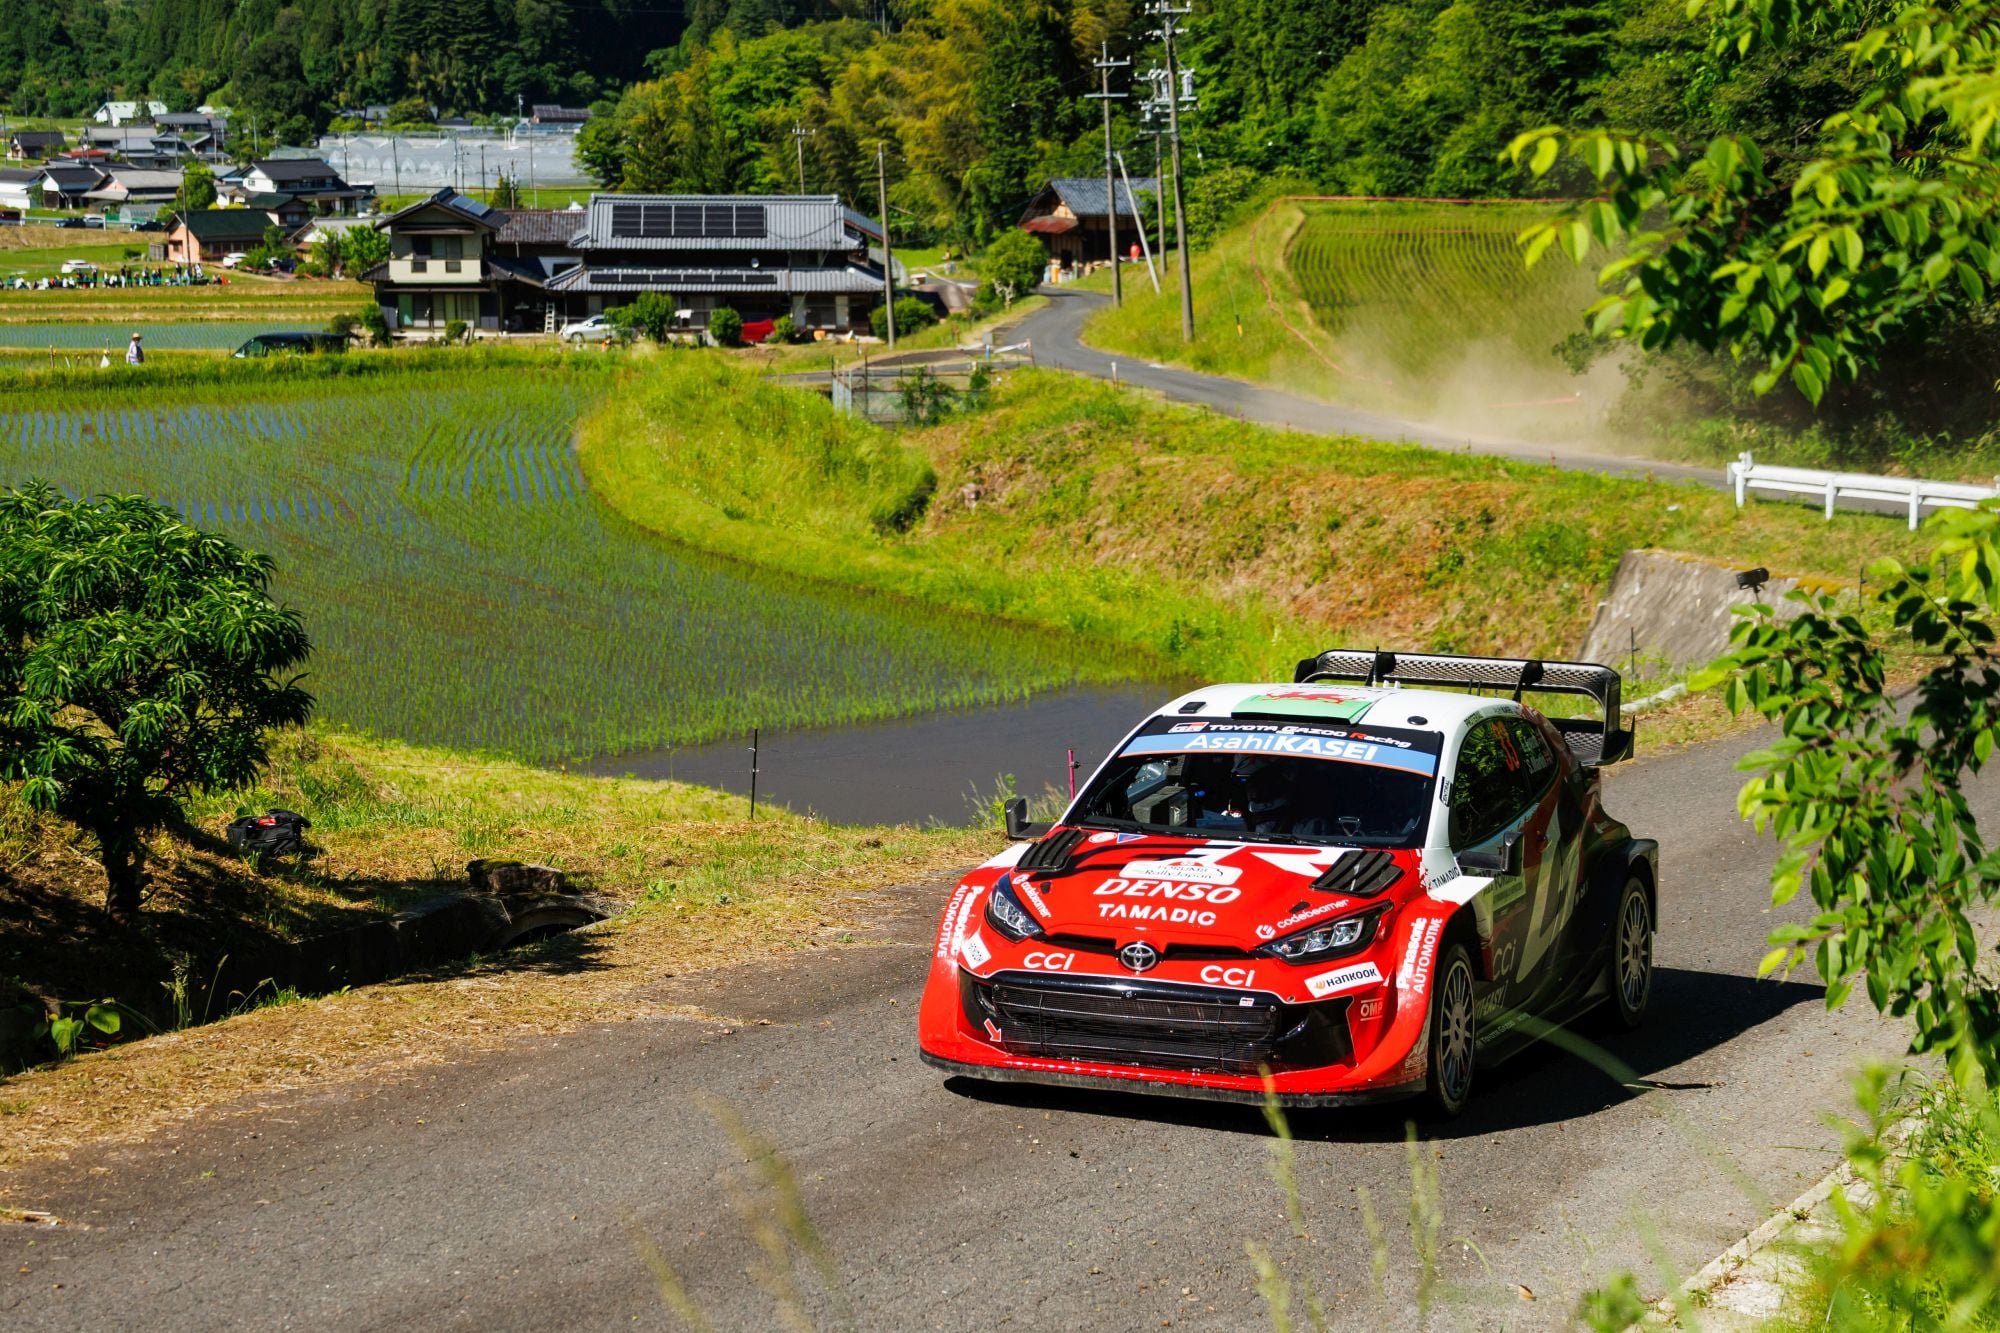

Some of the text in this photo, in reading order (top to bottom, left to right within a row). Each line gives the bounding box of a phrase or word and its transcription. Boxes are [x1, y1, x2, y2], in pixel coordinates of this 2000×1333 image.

[1208, 723, 1278, 734] TOYOTA
[1277, 725, 1348, 738] GAZOO
[1349, 731, 1412, 749] Racing
[1432, 866, 1460, 888] TAMADIC
[1092, 878, 1242, 904] DENSO
[937, 884, 969, 958] AUTOMOTIVE
[1098, 903, 1217, 926] TAMADIC
[1277, 899, 1350, 929] codebeamer
[1023, 952, 1075, 970] CCI
[1396, 917, 1428, 990] Panasonic
[1413, 917, 1444, 994] AUTOMOTIVE
[1200, 965, 1256, 987] CCI
[1360, 1001, 1383, 1017] OMP
